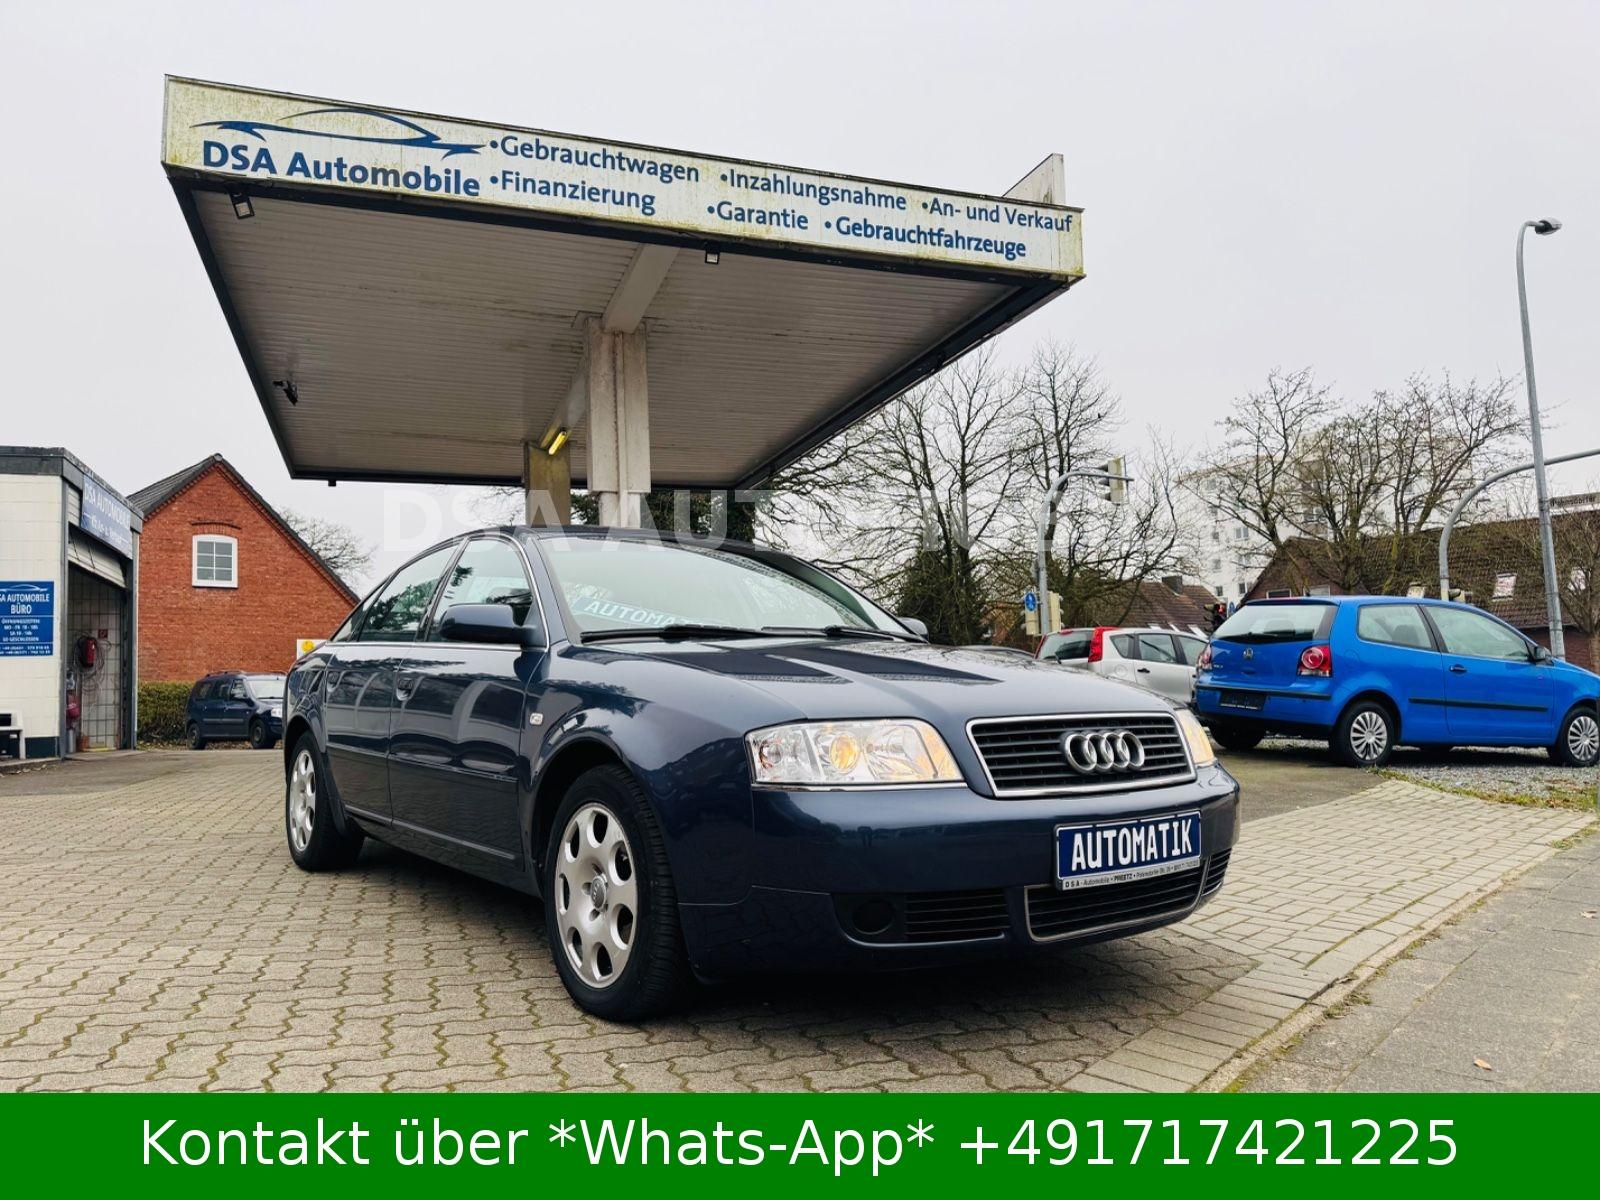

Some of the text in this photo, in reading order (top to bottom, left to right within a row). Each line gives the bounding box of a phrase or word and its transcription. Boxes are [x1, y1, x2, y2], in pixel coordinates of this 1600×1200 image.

[203, 140, 480, 197] DSA Automobile
[500, 135, 700, 184] Gebrauchtwagen
[501, 170, 656, 216] Finanzierung
[729, 168, 907, 210] Inzahlungsnahme
[716, 201, 809, 230] Garantie
[929, 196, 1073, 233] An- und Verkauf
[835, 216, 1027, 259] Gebrauchtfahrzeuge
[7, 593, 50, 603] AUTOMOBILE
[10, 602, 32, 614] BÜRO
[584, 600, 690, 627] AUTOMA
[1071, 819, 1193, 872] AUTOMATIK
